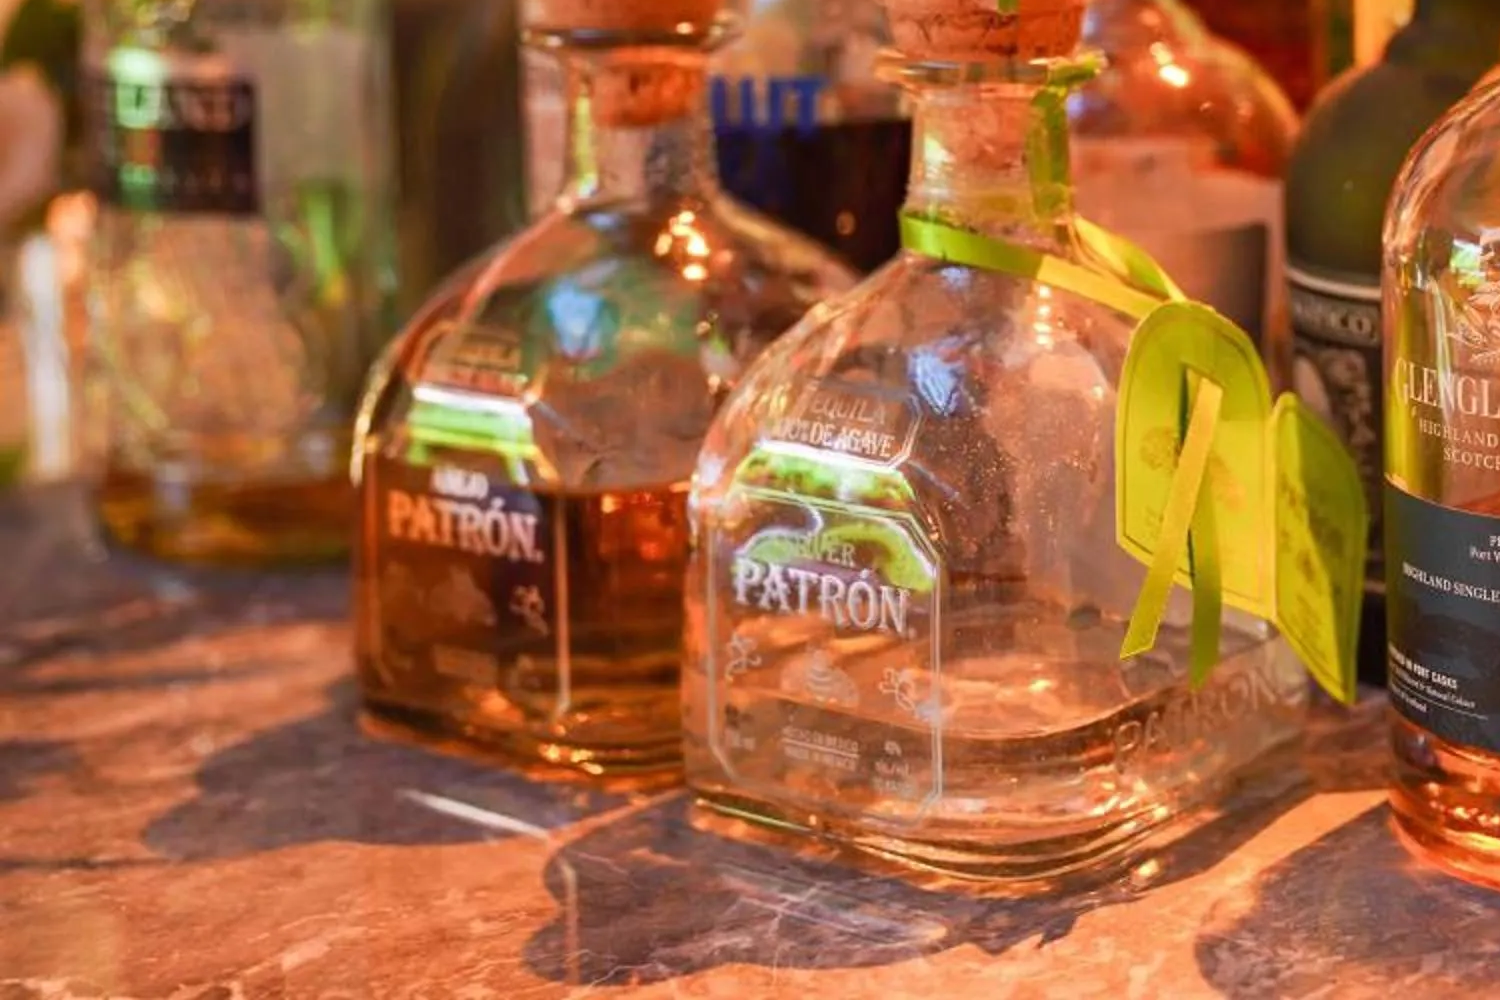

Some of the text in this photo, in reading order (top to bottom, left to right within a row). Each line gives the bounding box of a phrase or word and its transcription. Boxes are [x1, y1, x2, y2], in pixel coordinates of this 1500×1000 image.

[1418, 417, 1499, 448] HIGHLAND
[388, 490, 539, 560] PATRÓN
[734, 558, 910, 633] PATRÓN
[1402, 561, 1451, 592] HIGHLAND
[1453, 581, 1500, 603] SINGLE
